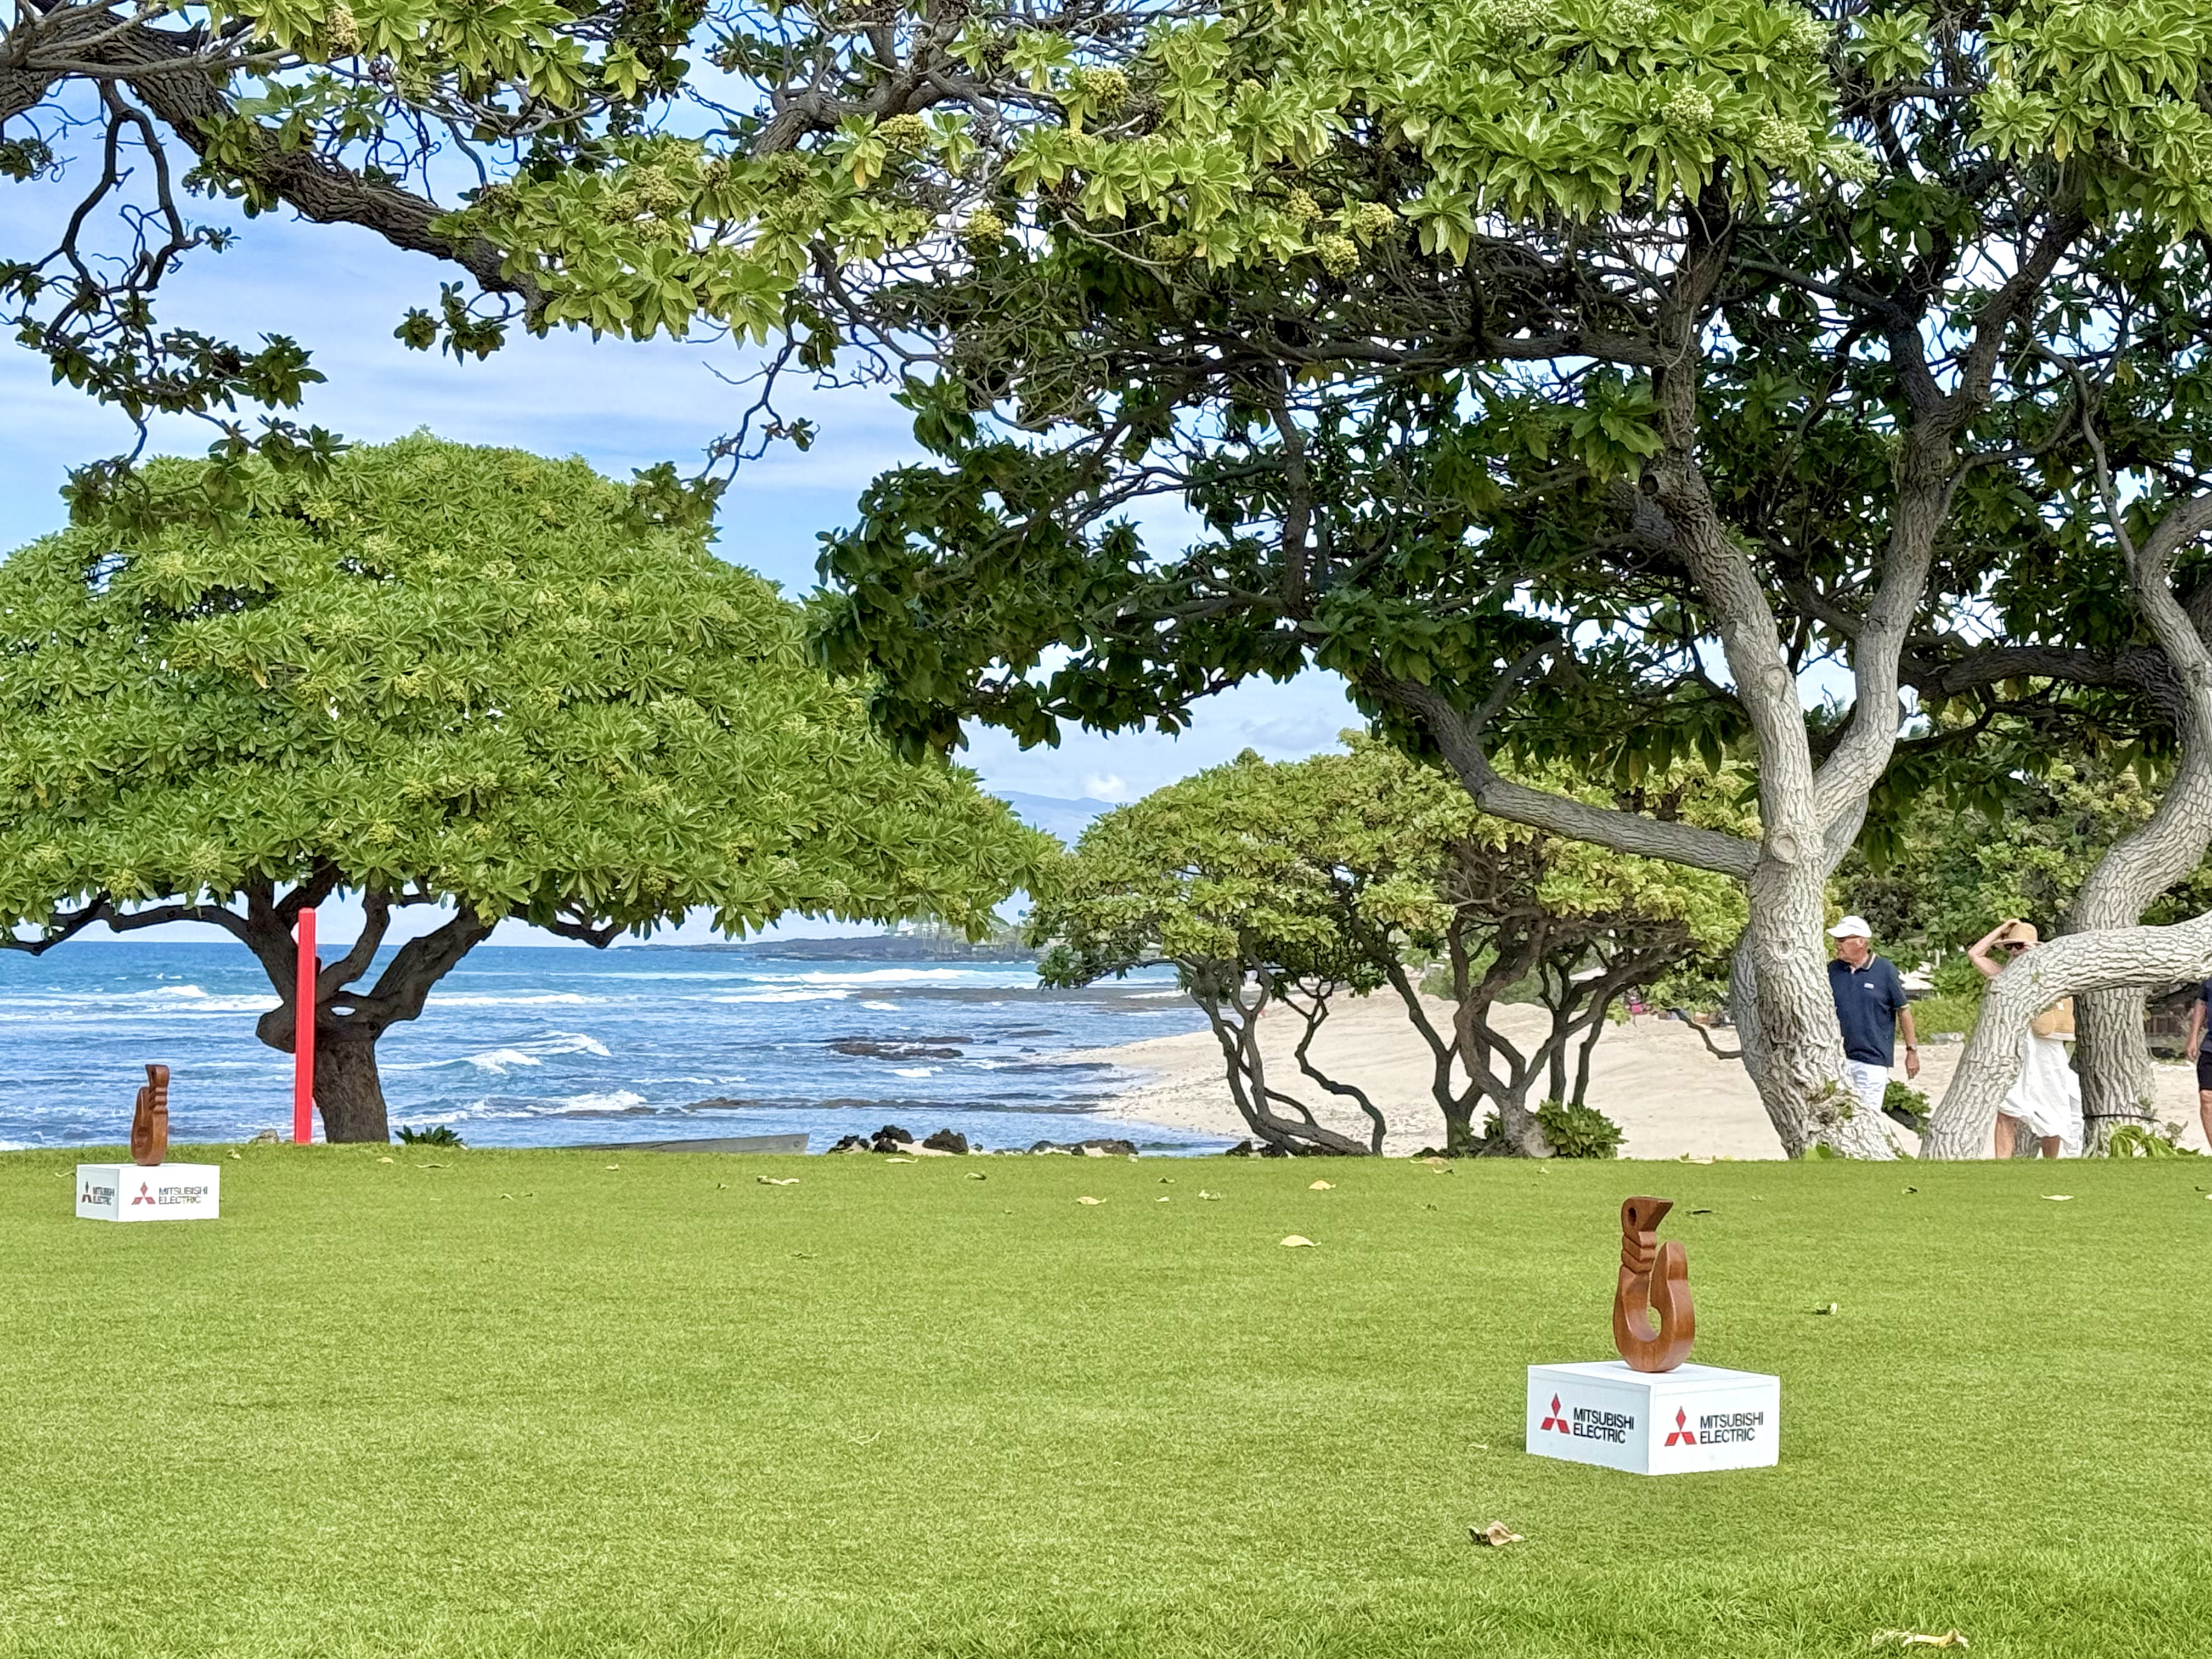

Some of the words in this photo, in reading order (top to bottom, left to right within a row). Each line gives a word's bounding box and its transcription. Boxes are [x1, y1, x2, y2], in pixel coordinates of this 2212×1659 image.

[159, 1186, 208, 1195] MITSUBISHI
[159, 1196, 201, 1205] ELECTRIC
[1573, 1407, 1634, 1430] MITSUBISHI
[1700, 1412, 1764, 1429] MITSUBISHI
[1573, 1423, 1626, 1444] ELECTRIC
[1700, 1428, 1755, 1444] ELECTRIC
